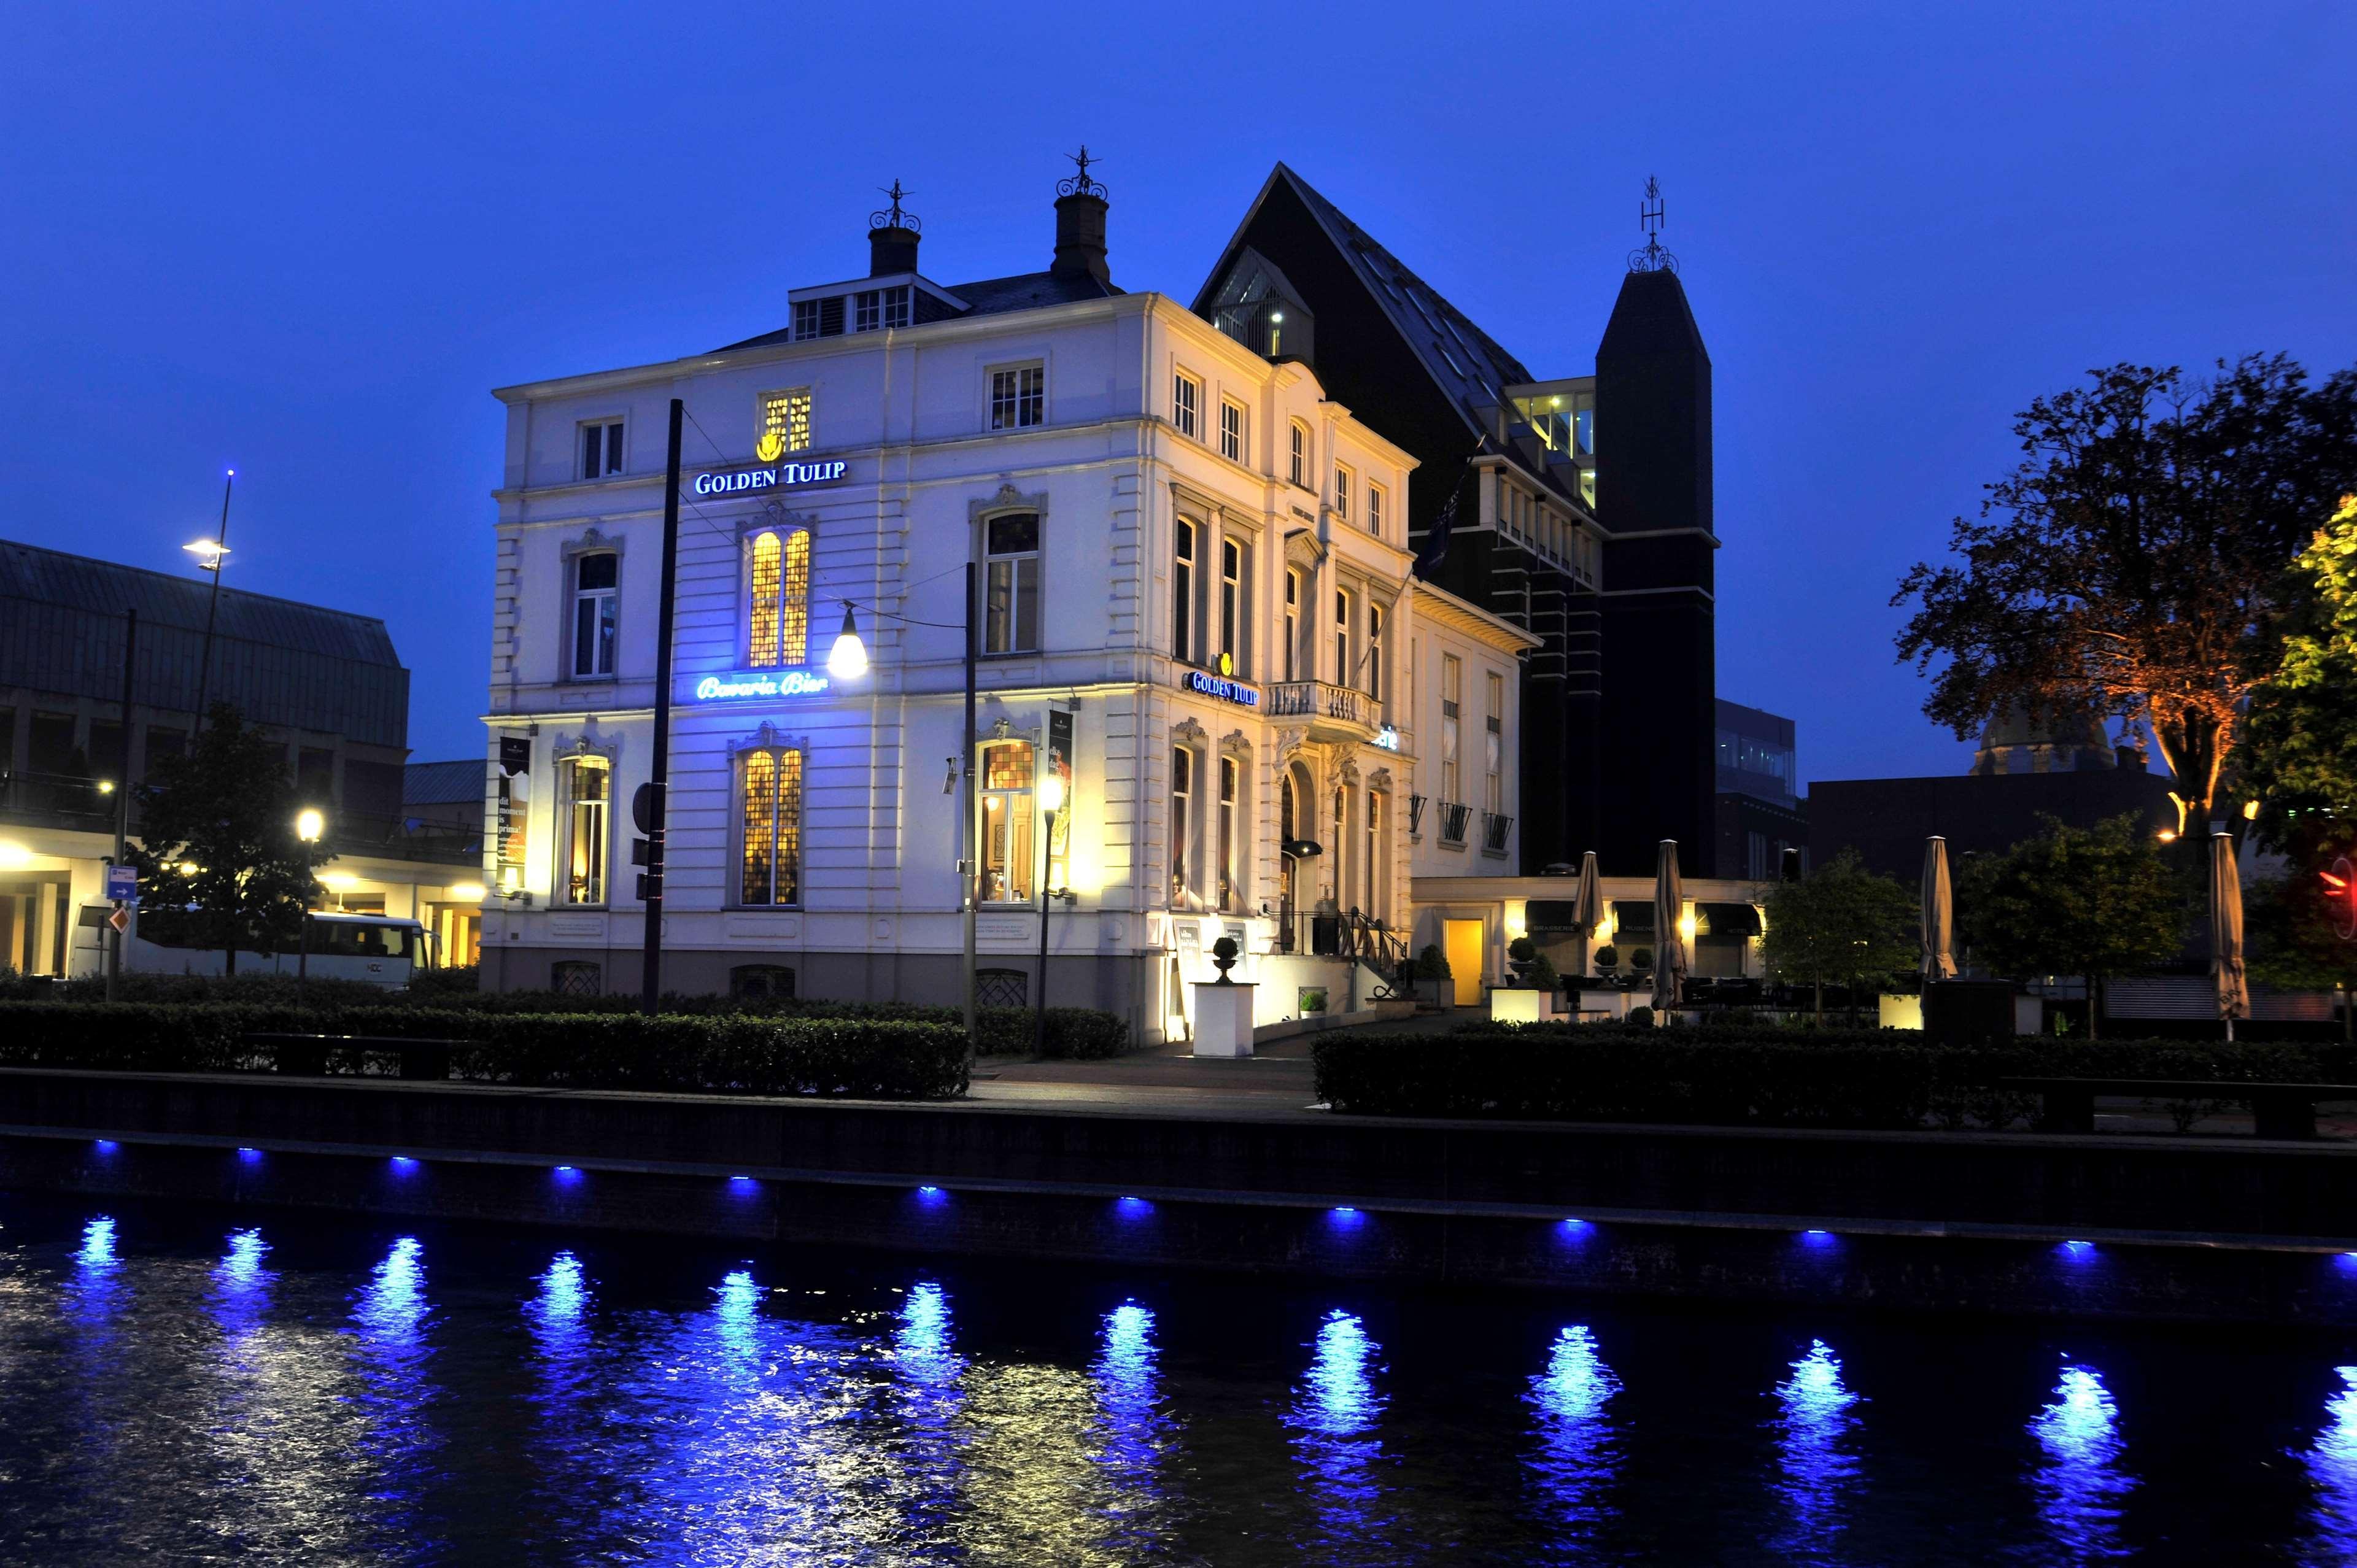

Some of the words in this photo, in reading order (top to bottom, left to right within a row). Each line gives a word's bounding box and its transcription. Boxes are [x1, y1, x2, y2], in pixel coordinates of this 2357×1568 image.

[695, 469, 776, 494] GOLDEN
[784, 462, 845, 484] TULIP
[697, 675, 778, 700] Bavaria
[780, 672, 829, 695] Bier
[1193, 672, 1231, 697] GOLDEN
[1233, 683, 1258, 705] TULIP
[1049, 746, 1061, 756] elke
[499, 797, 509, 805] dit
[499, 815, 505, 824] is
